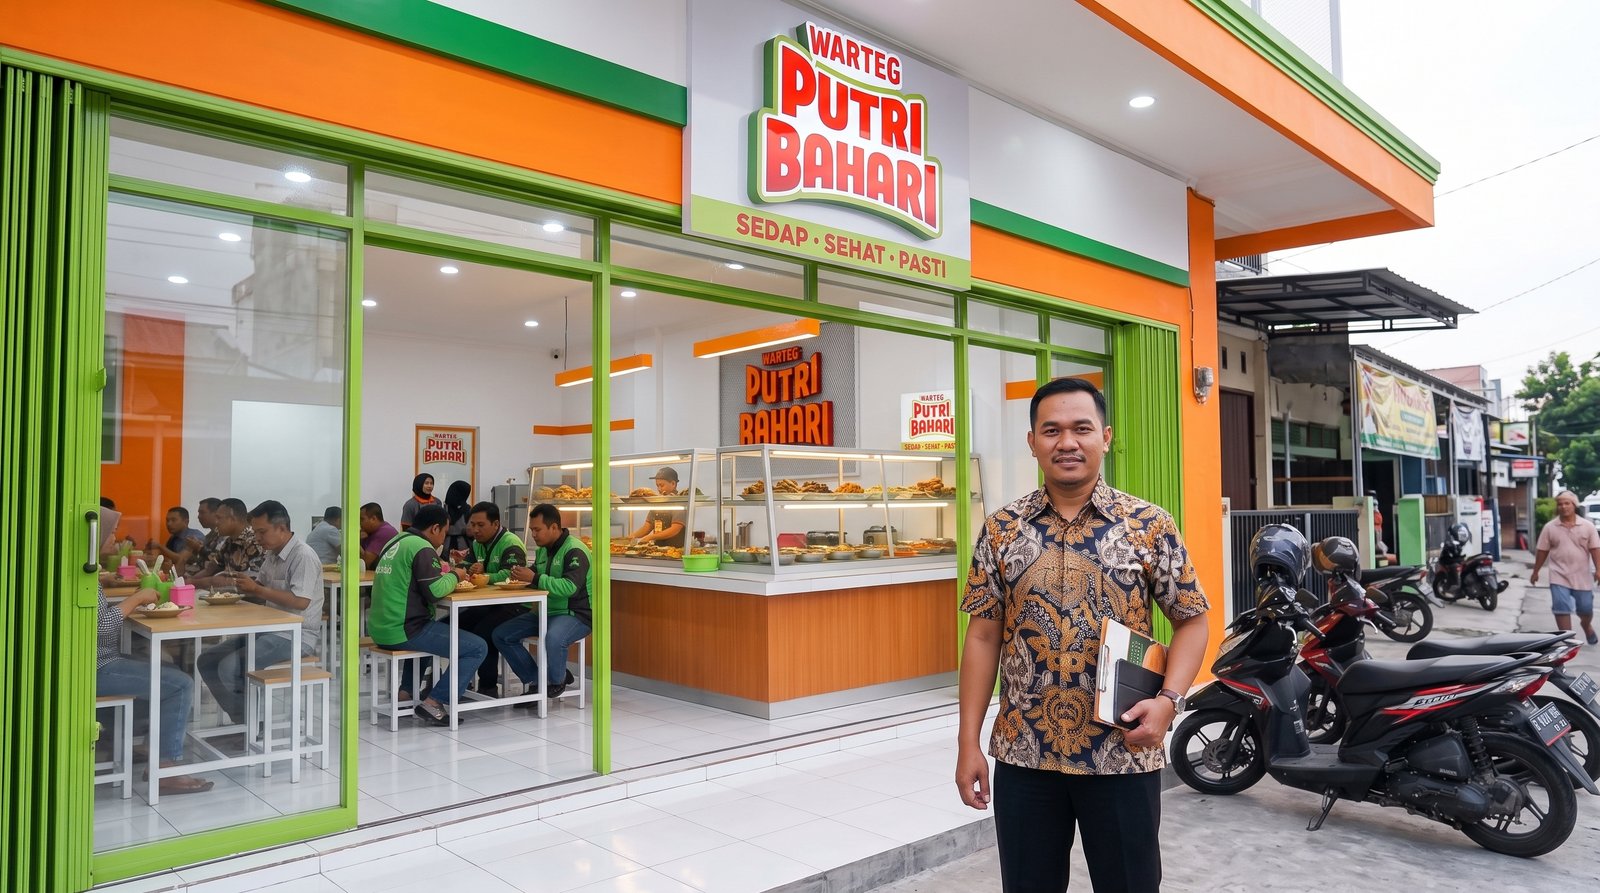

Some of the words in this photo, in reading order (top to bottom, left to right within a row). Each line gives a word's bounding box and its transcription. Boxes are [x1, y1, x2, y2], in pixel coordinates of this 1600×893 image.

[809, 25, 901, 85] WARTEG
[781, 45, 922, 156] PUTRI
[766, 117, 937, 230] BAHARI
[736, 212, 809, 247] SEDAP
[823, 233, 886, 264] SEHAT
[899, 250, 946, 278] PASTI
[762, 346, 800, 365] WARTEG
[746, 352, 820, 405] PUTRI
[739, 401, 831, 446] BAHARI
[911, 417, 954, 437] BAHARI
[913, 401, 950, 418] PUTRI
[425, 450, 465, 463] BAHARI
[428, 438, 462, 451] PUTRI
